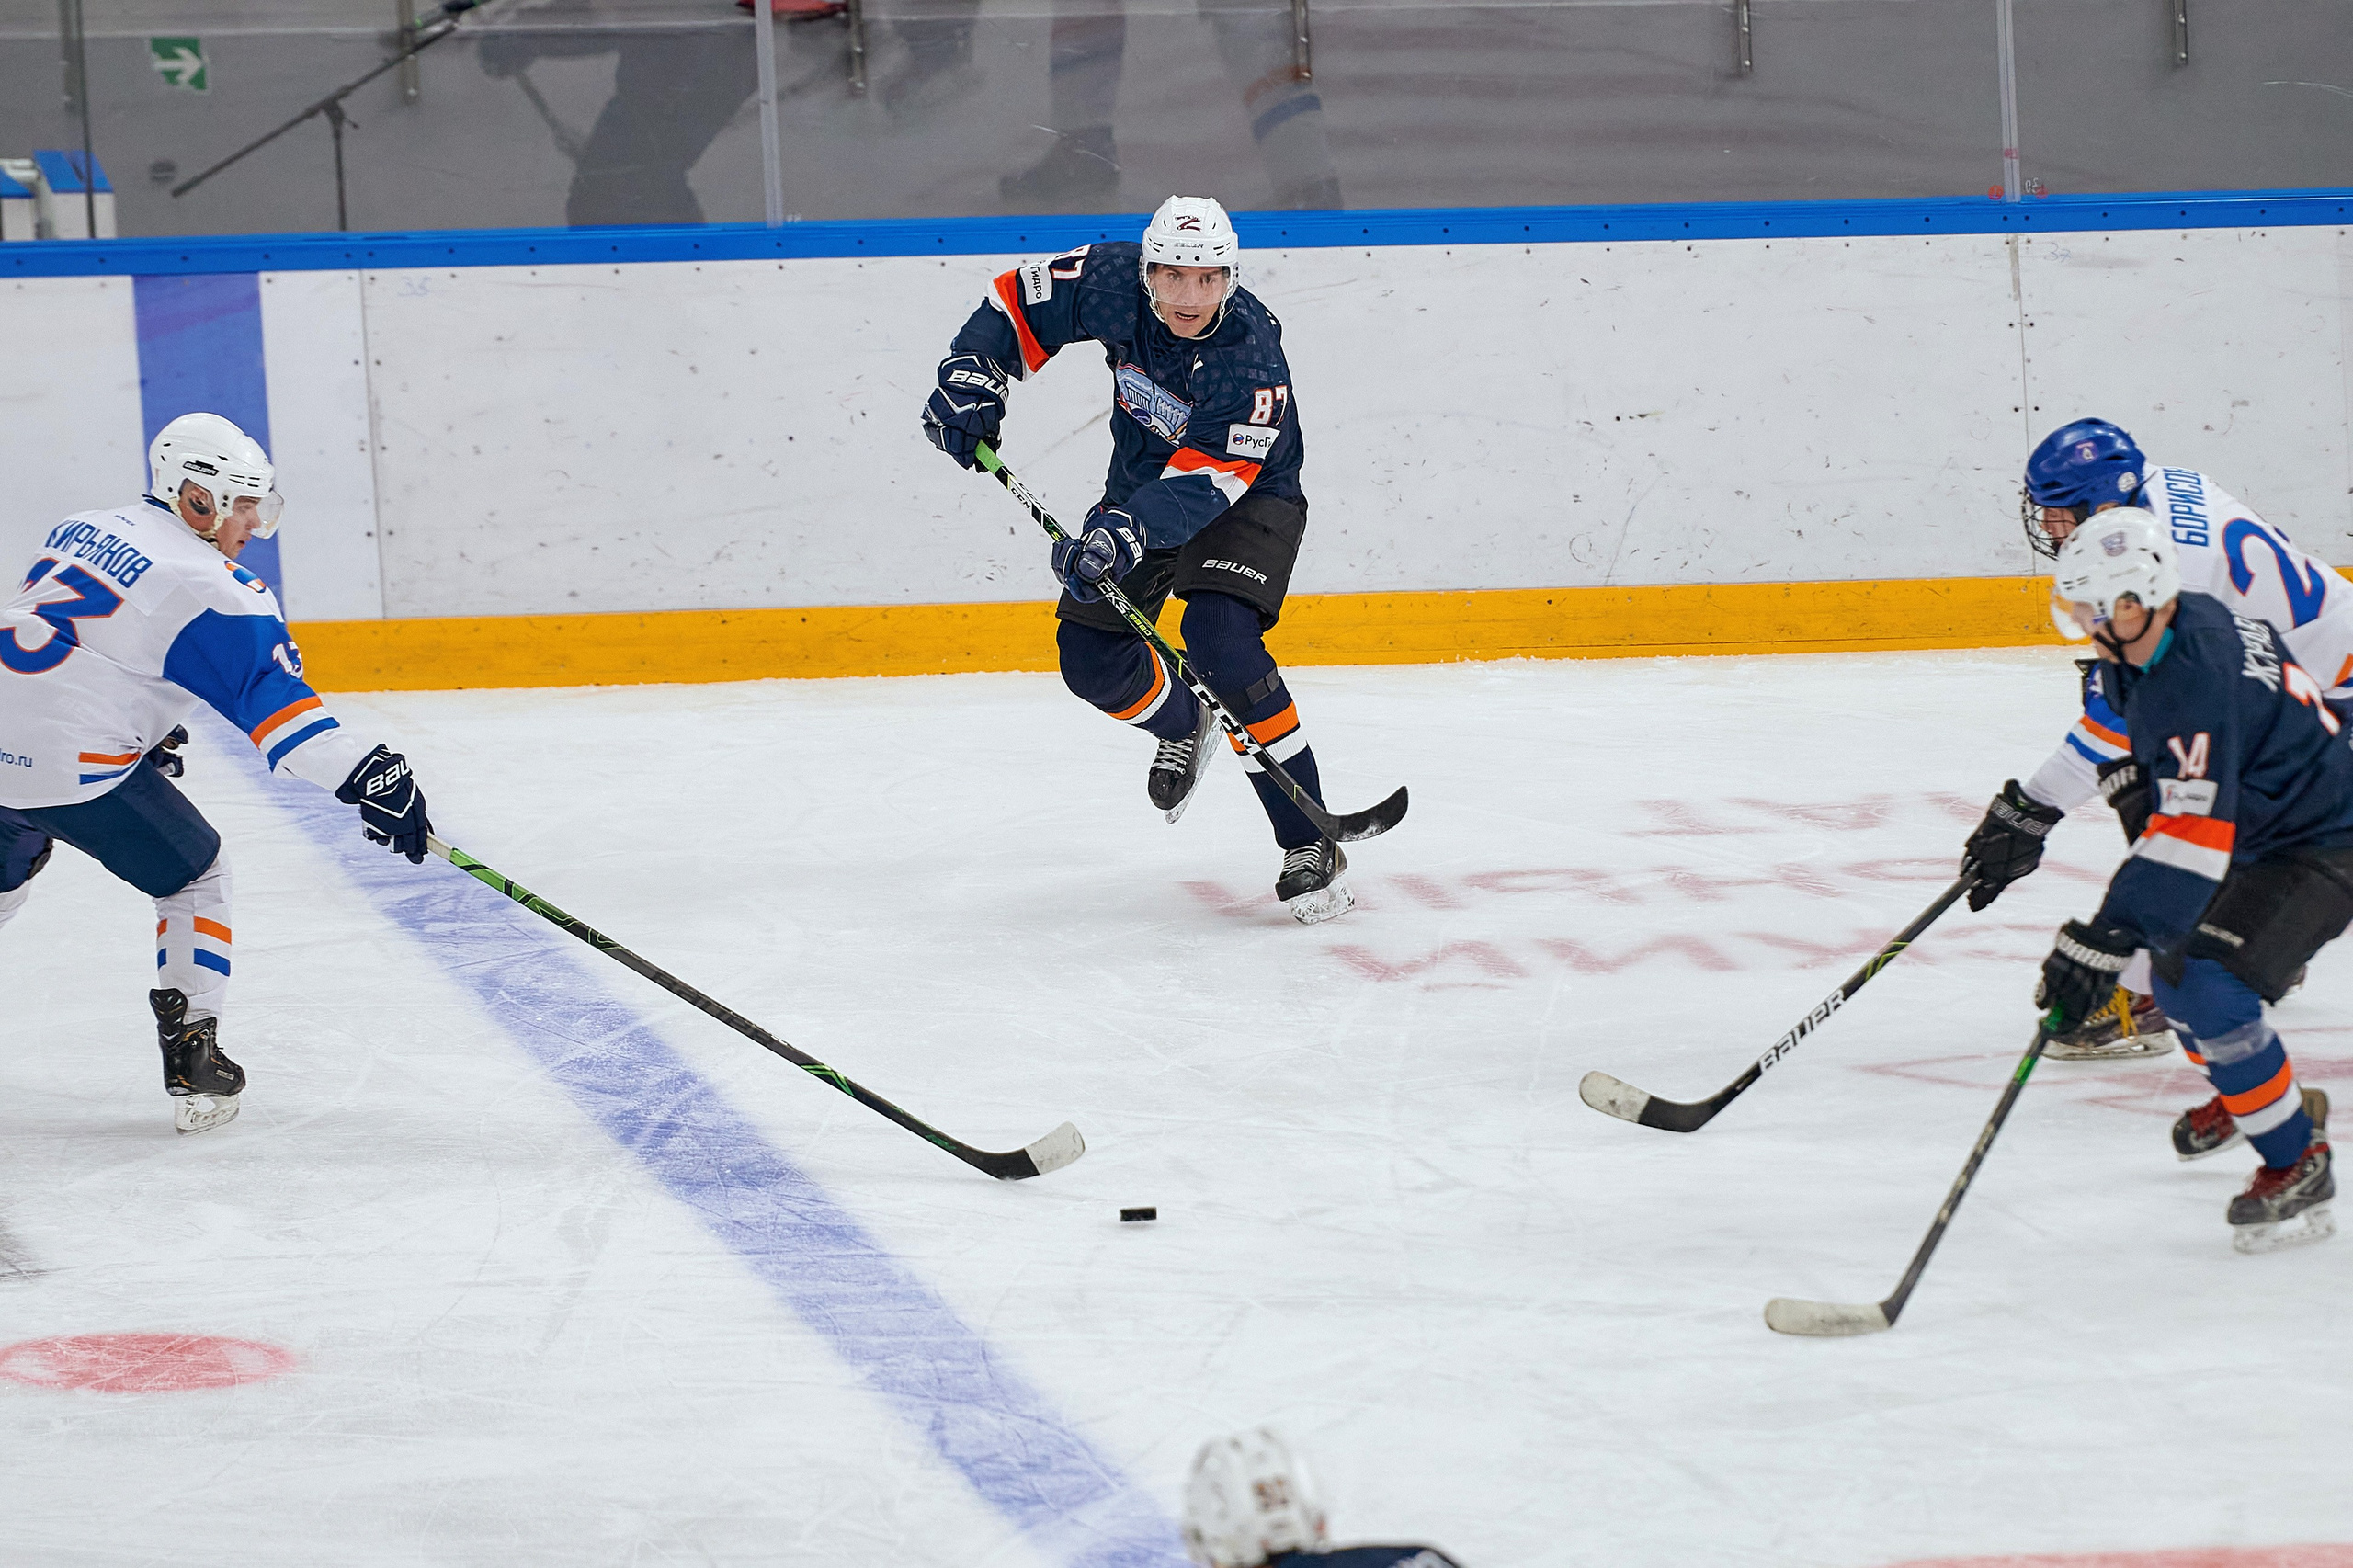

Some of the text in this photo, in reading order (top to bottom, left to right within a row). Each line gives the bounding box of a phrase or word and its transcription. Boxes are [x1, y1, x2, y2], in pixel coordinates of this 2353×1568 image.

[1030, 265, 1043, 300] Гидро
[946, 369, 1010, 404] BAUE
[1248, 385, 1288, 426] 87
[1245, 434, 1271, 449] РусГ
[1010, 487, 1031, 509] CCM
[44, 519, 153, 589] КИРЬЯНОВ
[1201, 559, 1268, 585] BAUER
[2221, 516, 2327, 630] 2
[1097, 580, 1131, 615] CKS
[272, 641, 304, 679] 13
[365, 759, 411, 797] BAU
[1758, 986, 1845, 1075] BAUER
